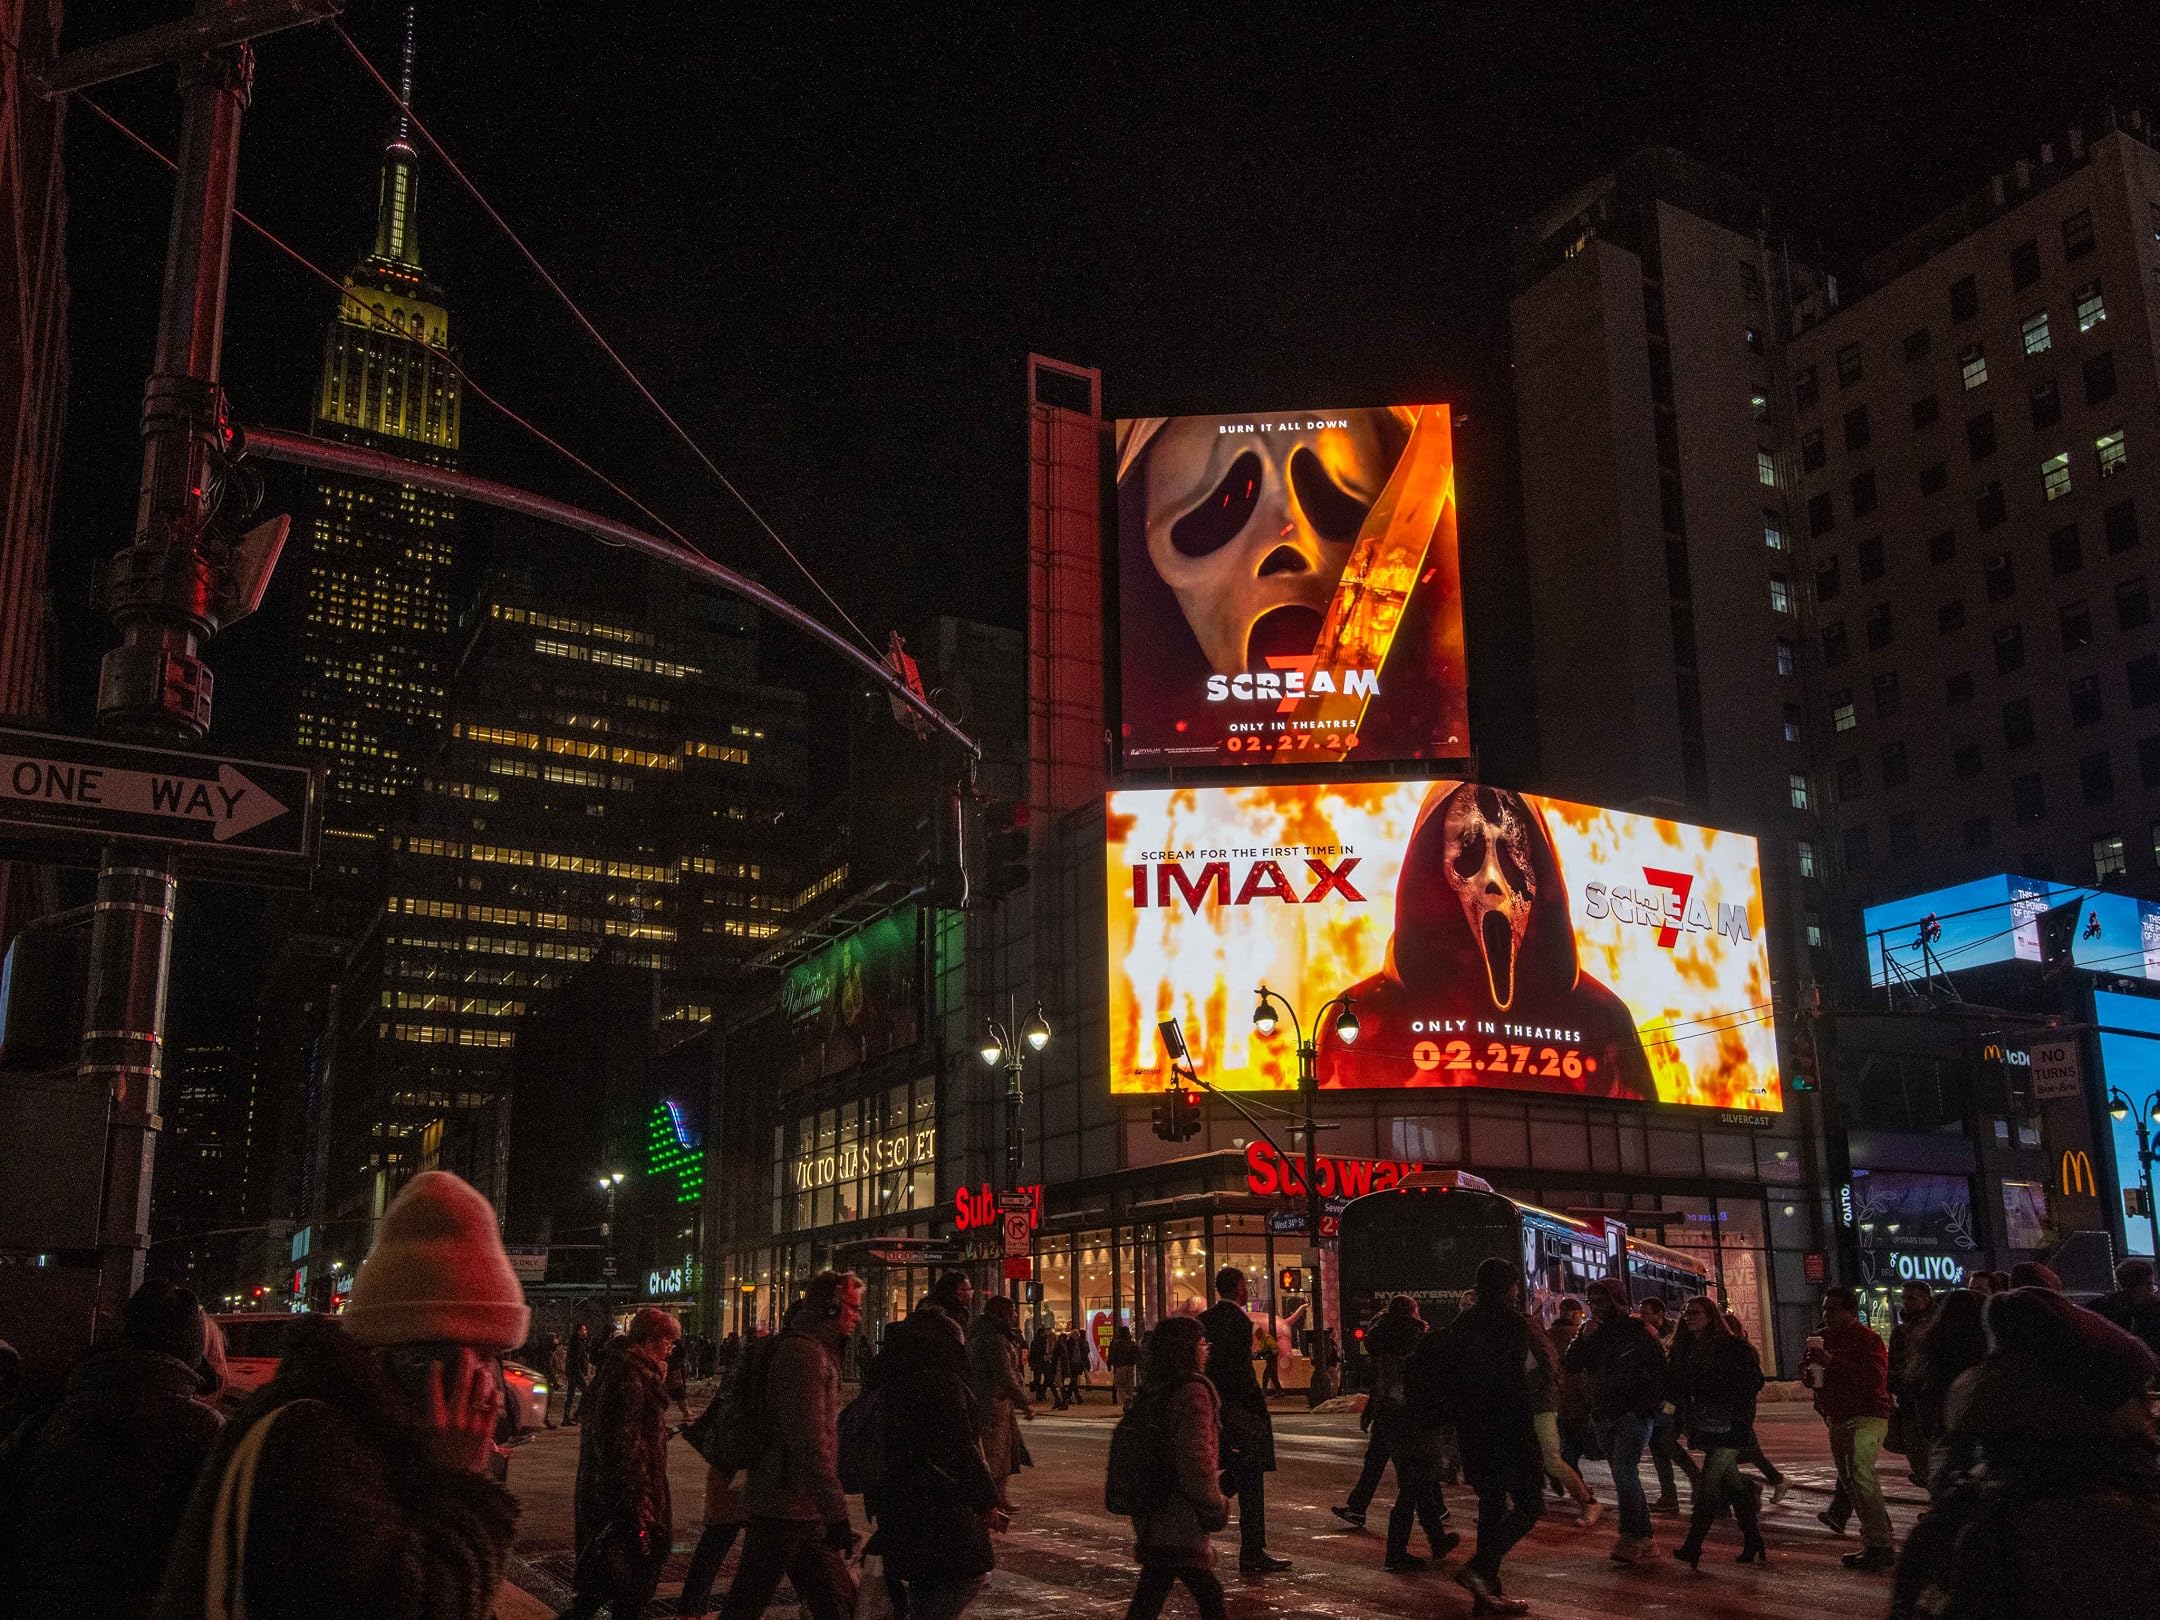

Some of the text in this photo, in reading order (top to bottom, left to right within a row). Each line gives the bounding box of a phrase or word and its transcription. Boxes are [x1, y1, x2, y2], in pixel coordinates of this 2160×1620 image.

[1219, 420, 1348, 434] BURN IT ALL DOWN
[1207, 669, 1380, 701] SCREAM
[1264, 655, 1319, 712] 7
[1229, 719, 1357, 732] ONLY IN THEATRES
[1227, 733, 1360, 752] 02.27.26
[12, 761, 246, 819] ONE WAY
[1141, 845, 1354, 861] SCREAM FOR THE FIRST TIME IN
[1132, 858, 1368, 916] IMAX
[1585, 881, 1752, 945] SCREAM
[1641, 866, 1694, 948] 7
[2013, 907, 2023, 917] OF
[2025, 900, 2049, 912] POWER
[1412, 1020, 1581, 1042] ONLY IN THEATRES
[1412, 1040, 1583, 1079] 02.27.26
[2041, 1048, 2065, 1063] NO
[2035, 1066, 2076, 1081] TURNS
[1721, 1113, 1770, 1126] SILVERCAST
[956, 1183, 1041, 1231] Suby
[1841, 1187, 1853, 1222] OLIYO
[1274, 1220, 1288, 1230] West
[1323, 1216, 1334, 1233] 2
[1899, 1255, 1956, 1281] OLIYO
